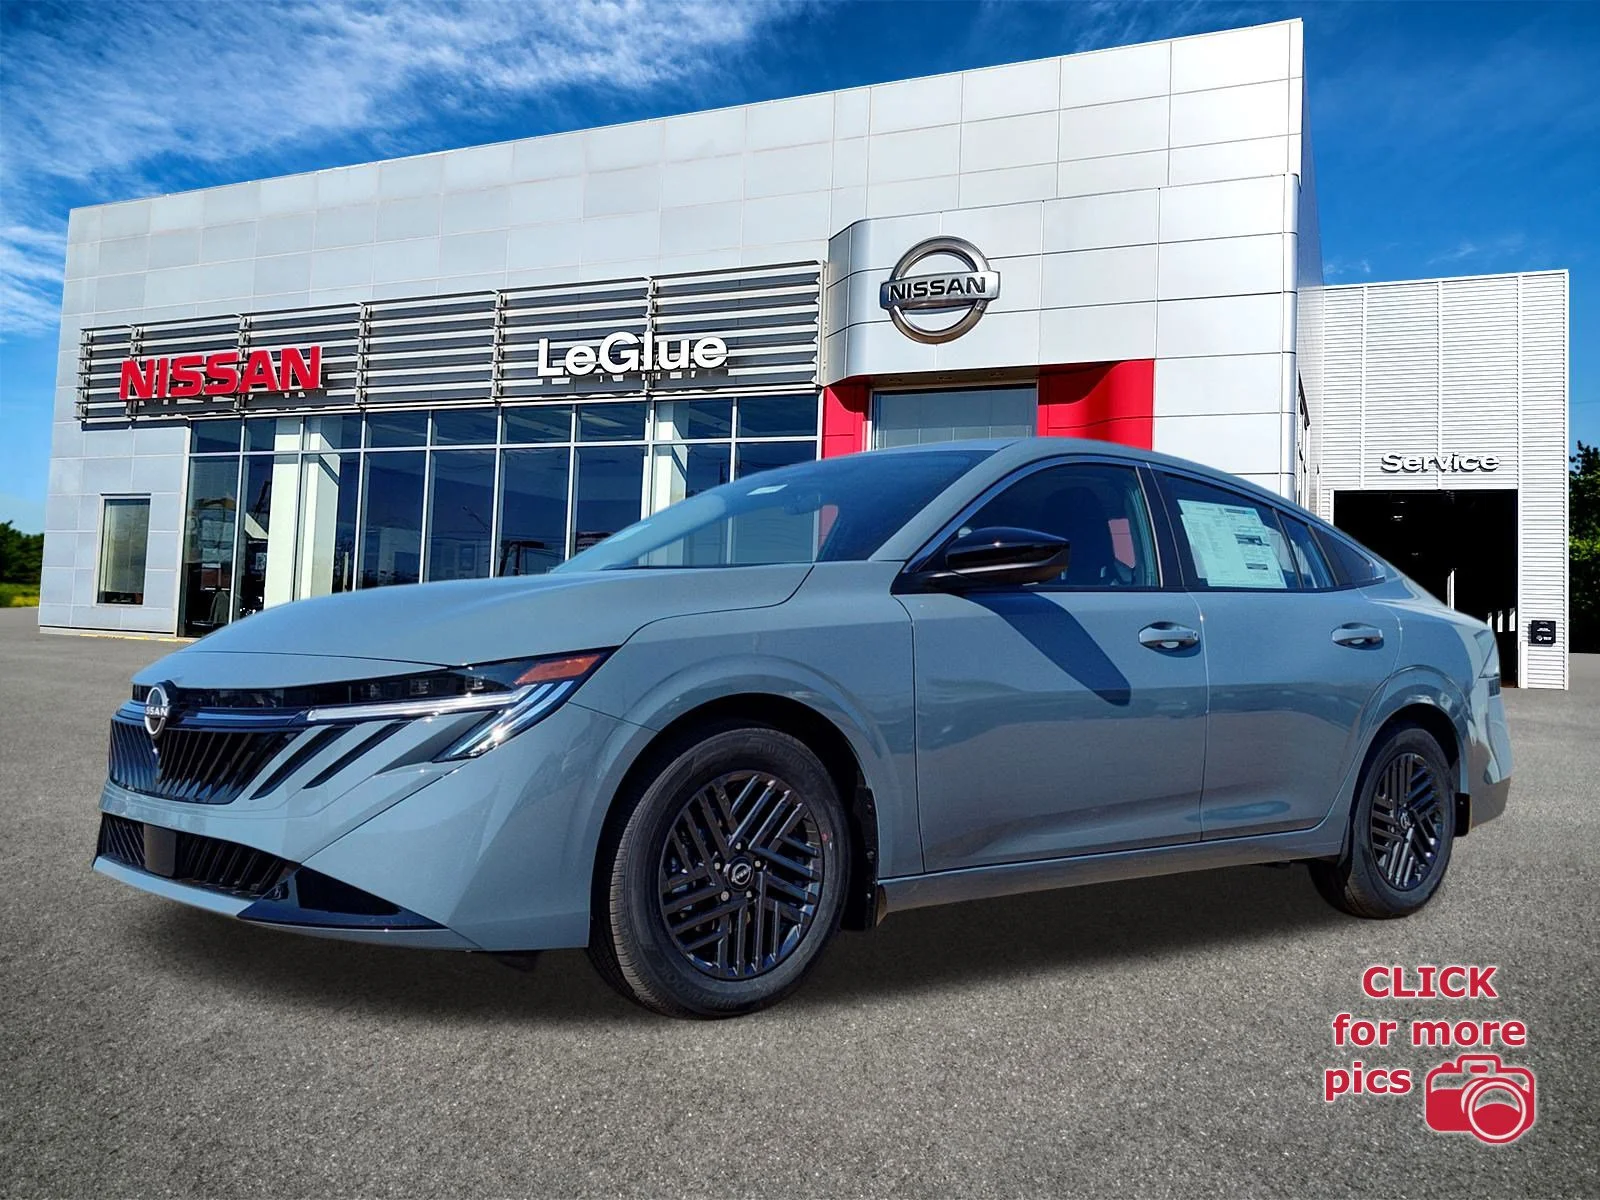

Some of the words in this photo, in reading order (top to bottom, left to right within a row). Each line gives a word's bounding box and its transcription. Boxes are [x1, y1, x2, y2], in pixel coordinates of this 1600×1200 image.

[888, 276, 986, 301] NISSAN
[537, 331, 729, 377] LeGlue
[119, 345, 322, 400] NISSAN
[1381, 450, 1500, 473] Service
[145, 705, 169, 717] SSAN
